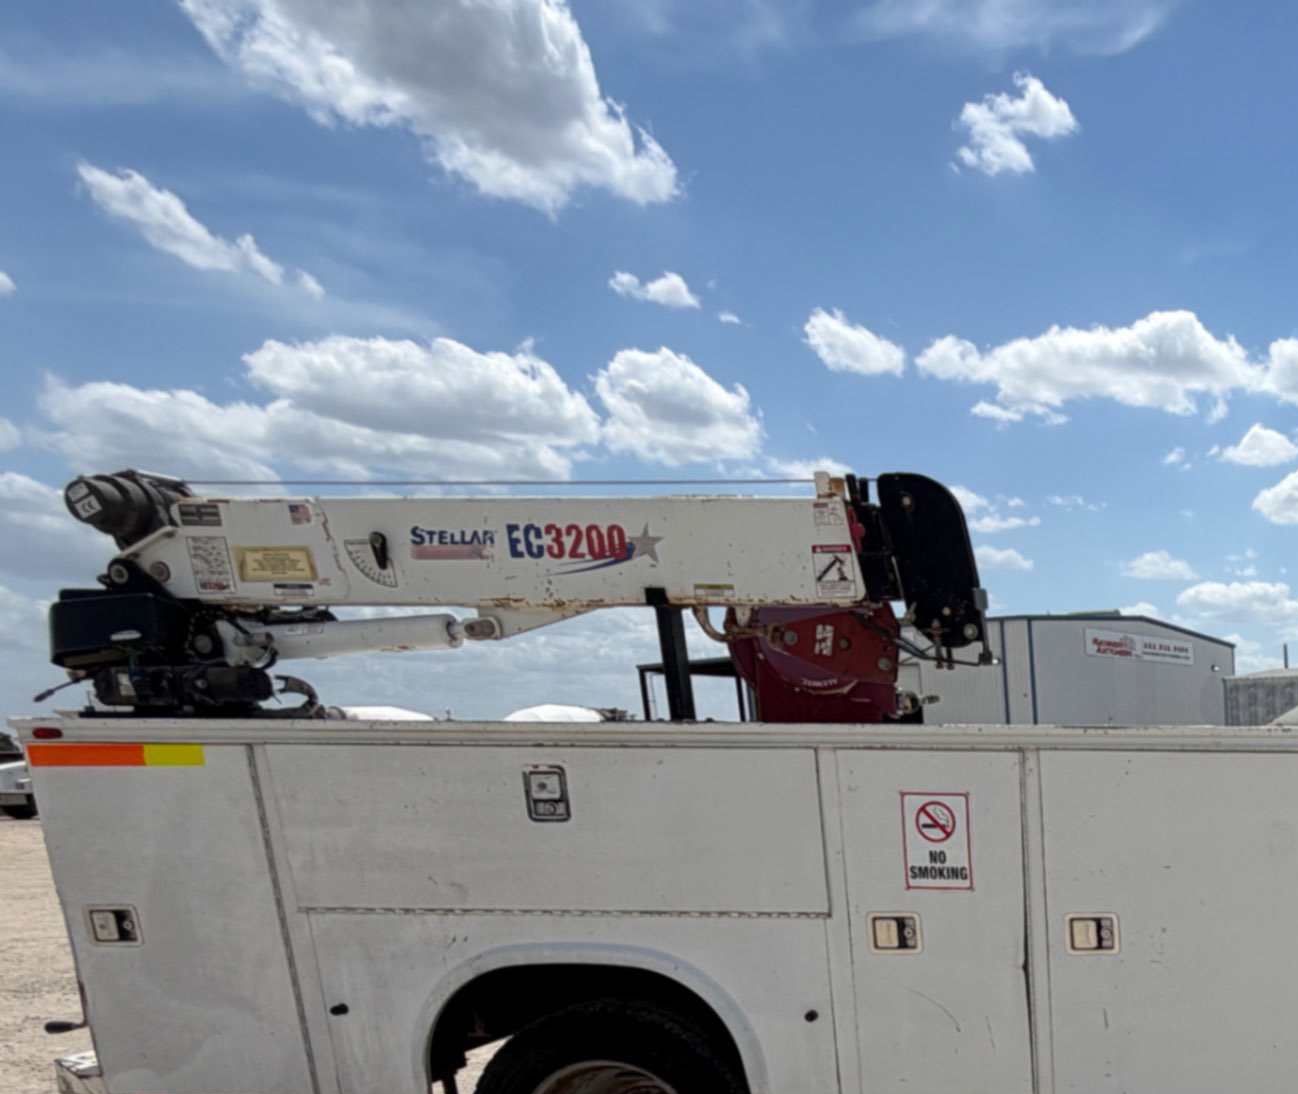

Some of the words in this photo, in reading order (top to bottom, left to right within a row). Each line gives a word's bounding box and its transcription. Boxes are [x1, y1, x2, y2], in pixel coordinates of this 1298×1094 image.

[410, 526, 495, 545] STELLAR
[506, 523, 628, 560] EC3200
[929, 850, 947, 864] NO
[910, 866, 968, 880] SMOKING
